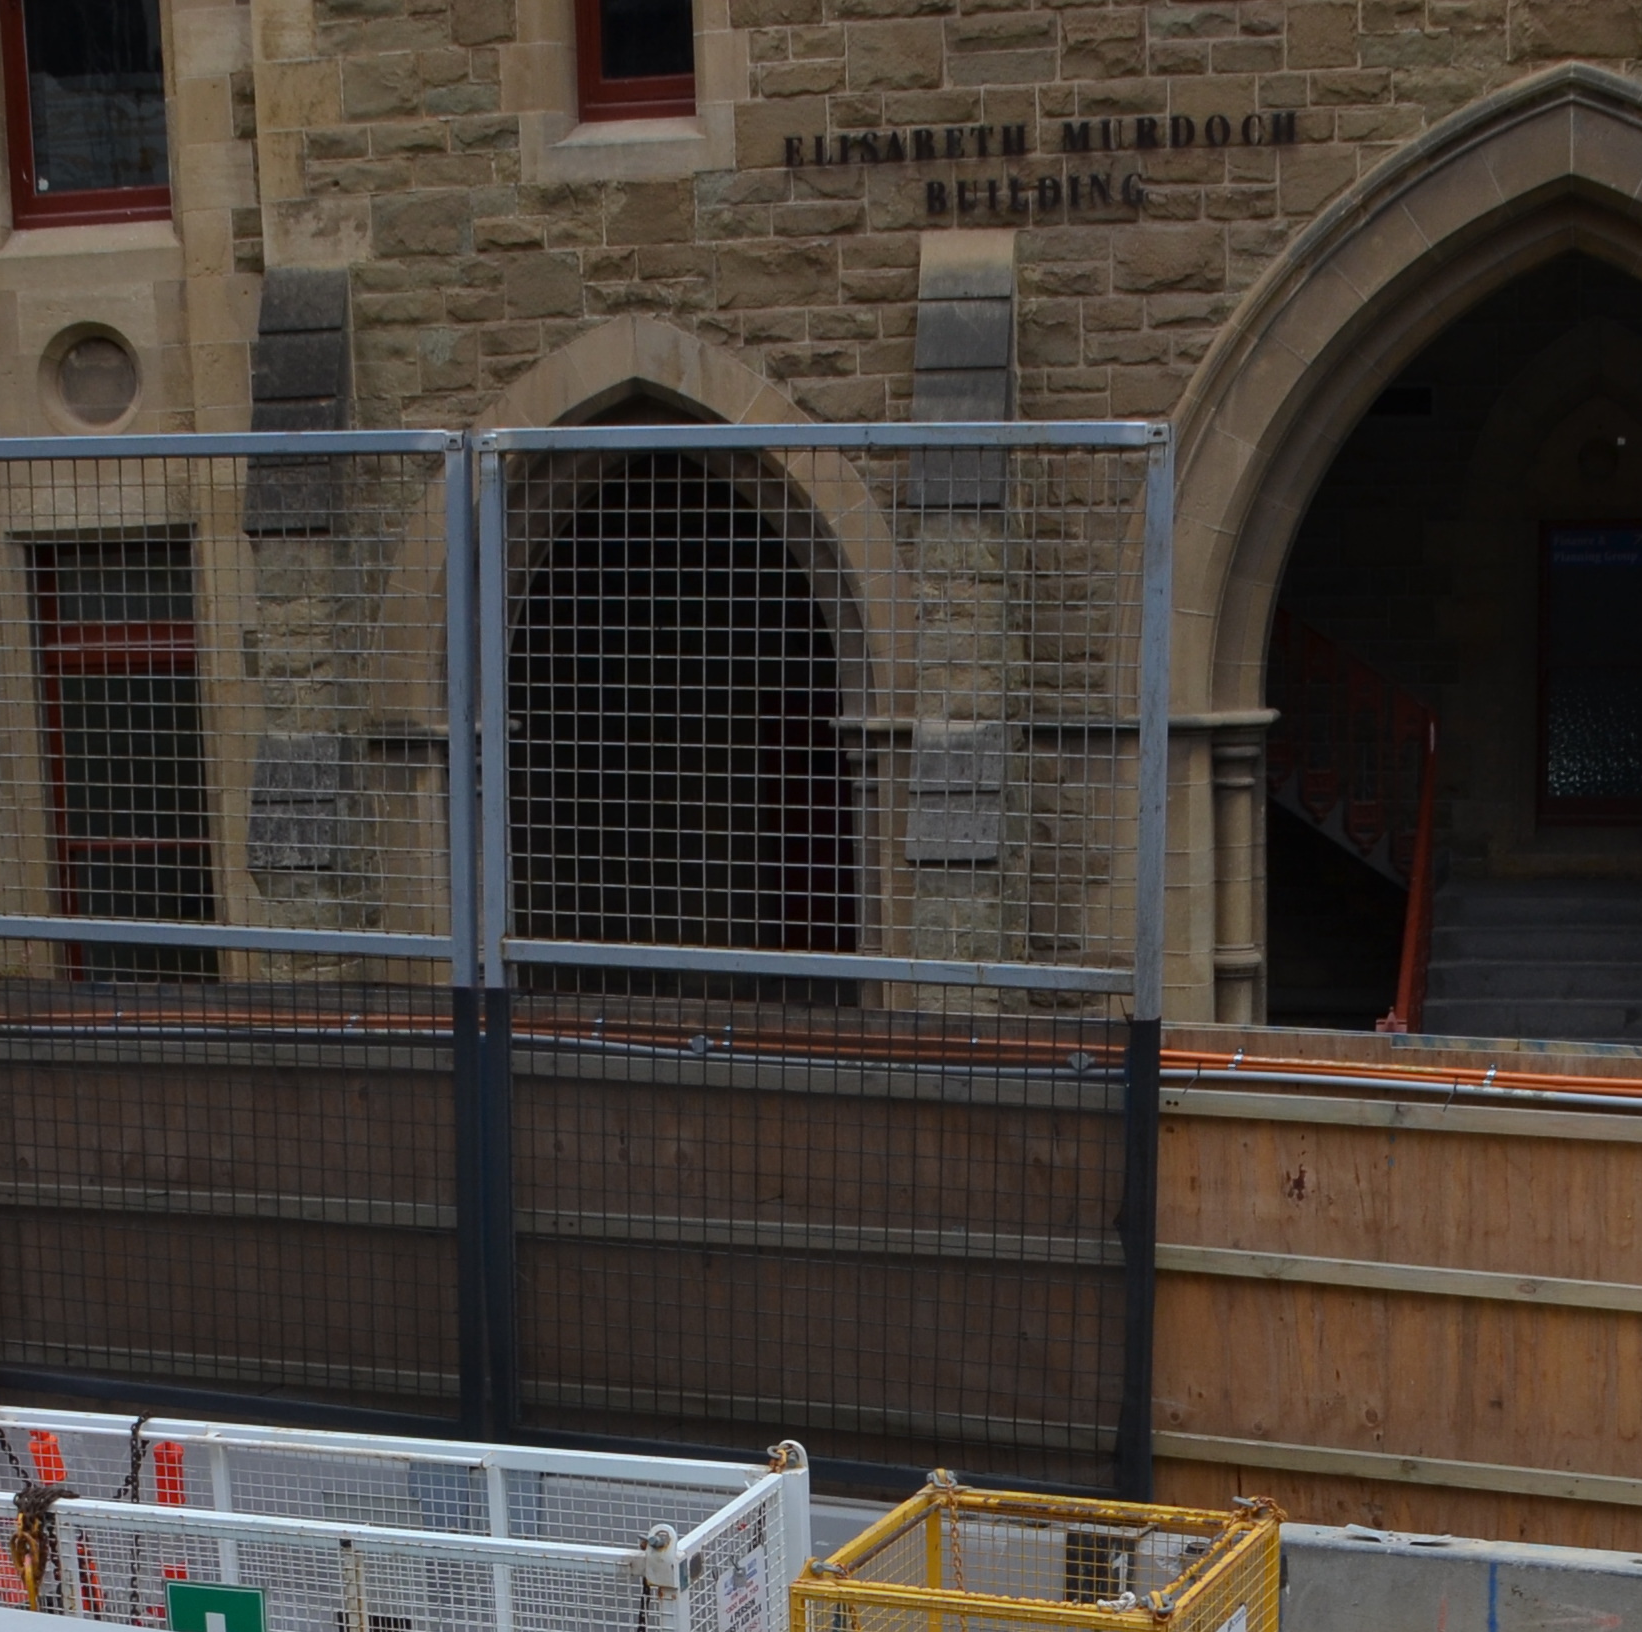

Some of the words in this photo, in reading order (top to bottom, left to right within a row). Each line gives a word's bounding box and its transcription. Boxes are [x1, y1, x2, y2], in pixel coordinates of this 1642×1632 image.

[783, 123, 1027, 168] ELISABETH
[1062, 111, 1298, 155] MURDOCH
[925, 171, 1146, 216] BUILDING
[1553, 551, 1603, 564] Planning
[1604, 550, 1638, 564] Group
[734, 1597, 756, 1621] PERSON
[741, 1612, 750, 1627] AID
[751, 1602, 762, 1619] BOX
